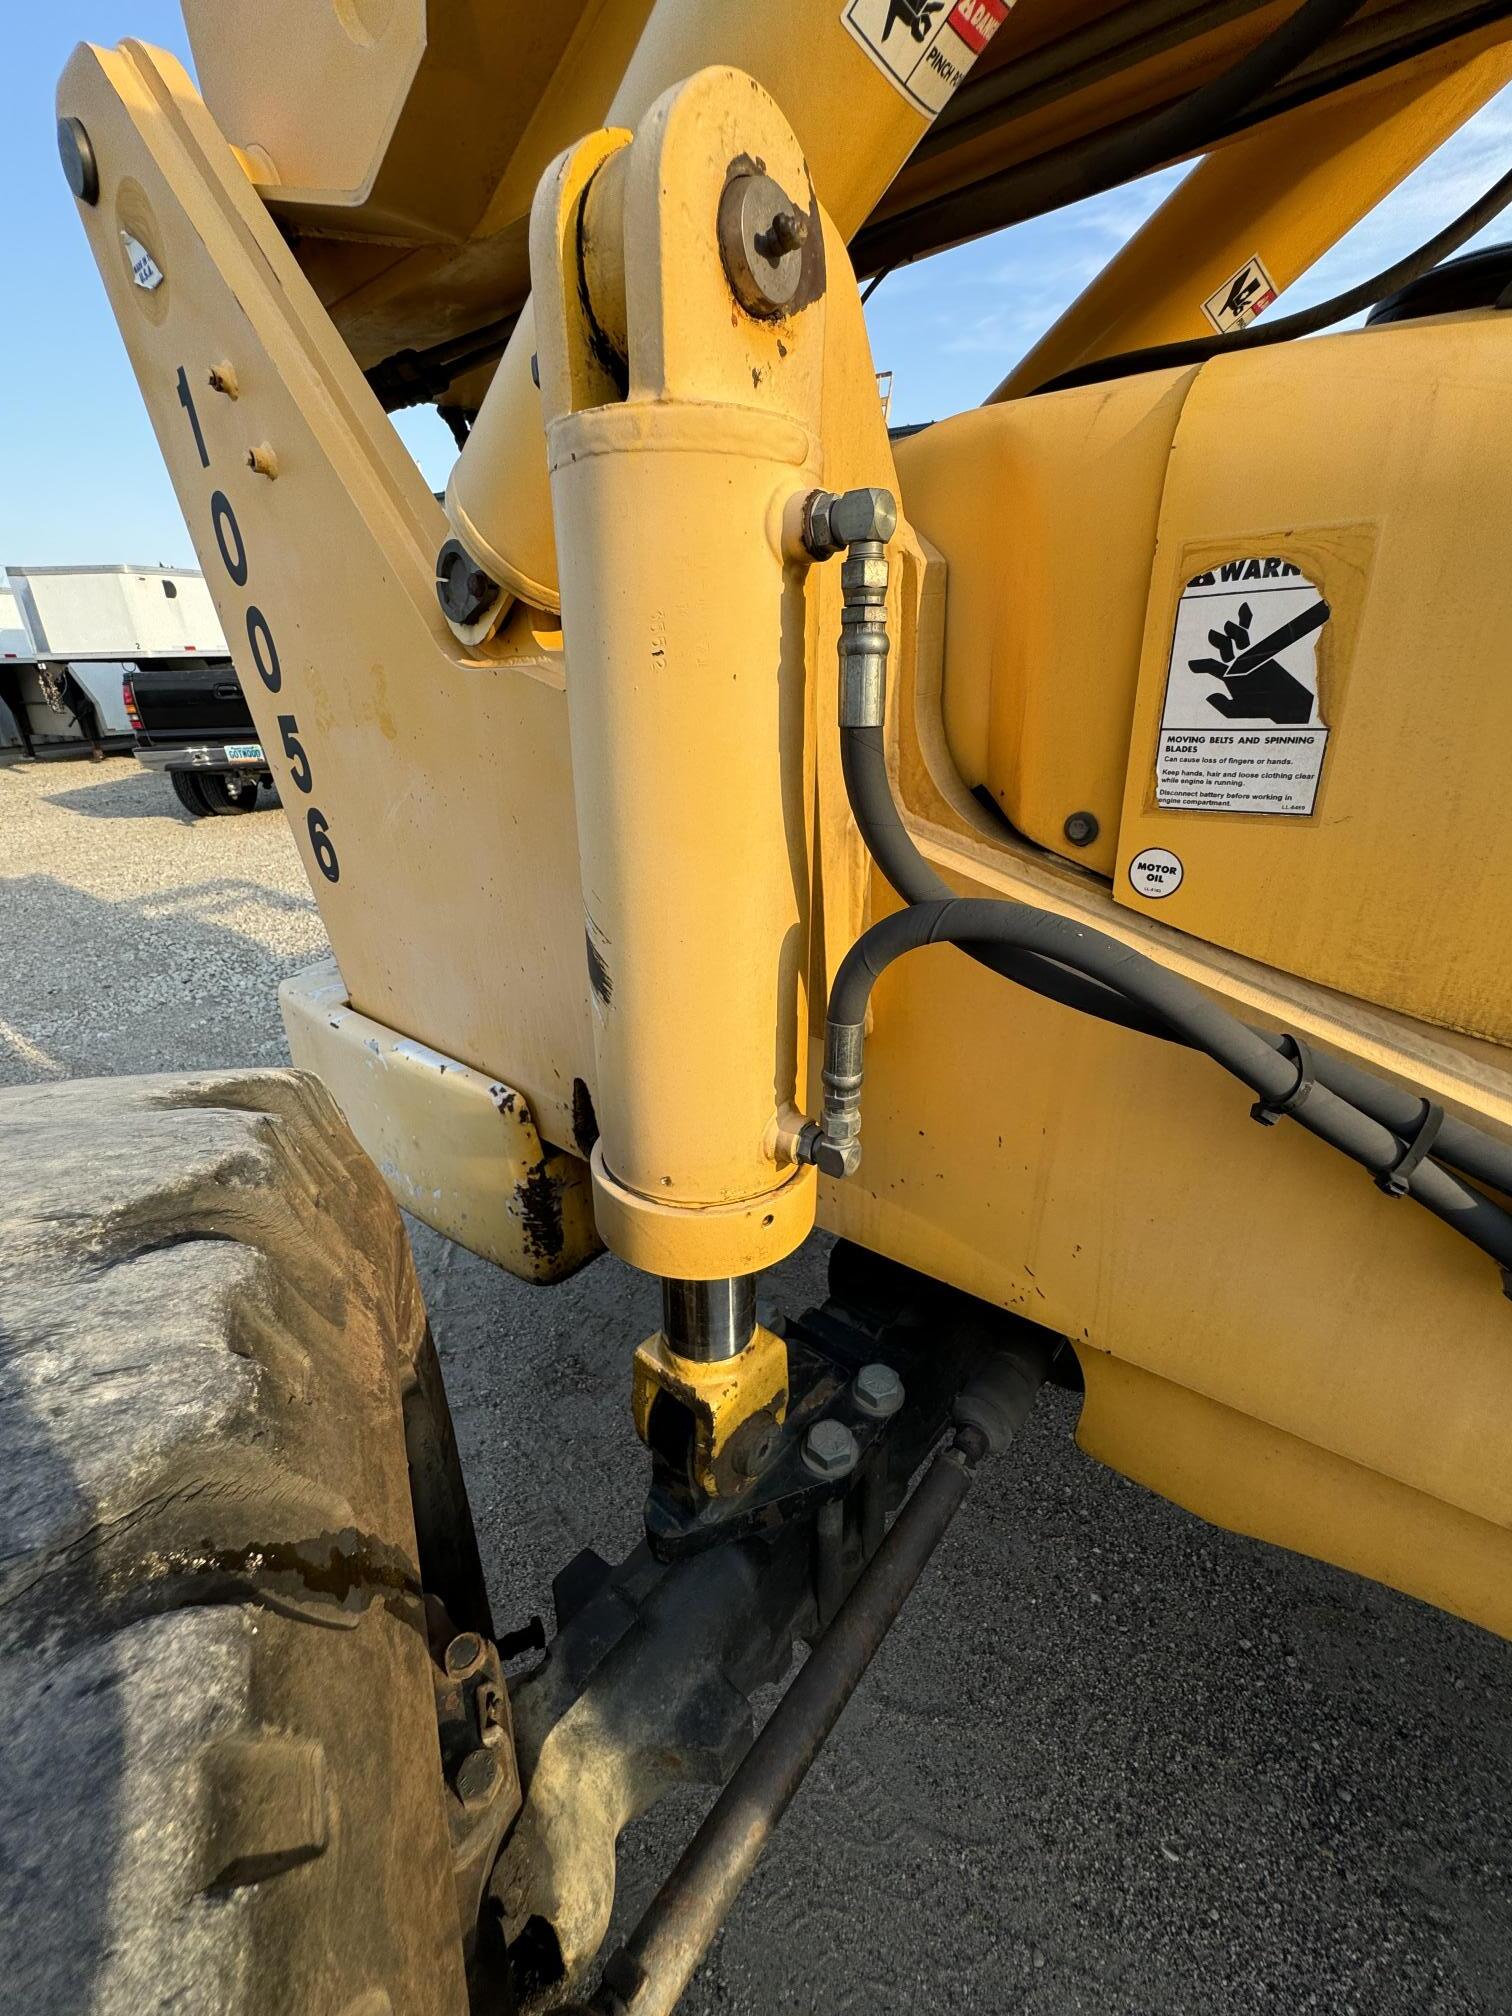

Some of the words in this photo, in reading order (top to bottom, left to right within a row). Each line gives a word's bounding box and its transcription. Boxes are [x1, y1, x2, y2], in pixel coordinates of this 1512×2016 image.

[926, 46, 955, 82] PINCH
[1167, 736, 1206, 744] MOVING
[1209, 736, 1234, 744] BELTS
[1237, 736, 1260, 744] AND
[1264, 736, 1315, 745] SPINNING
[1165, 745, 1198, 753] BLADES
[1202, 756, 1217, 764] loss
[1228, 757, 1255, 766] fingers
[1266, 757, 1293, 765] hands.
[1162, 769, 1180, 777] Keep
[1260, 772, 1293, 780] clothing
[1180, 778, 1204, 786] engine
[1159, 789, 1198, 797] Disconnect
[1199, 791, 1224, 799] battery
[1251, 793, 1283, 802] working
[1182, 799, 1232, 807] compartment.
[1137, 862, 1177, 876] MOTOR
[1146, 873, 1164, 883] OIL
